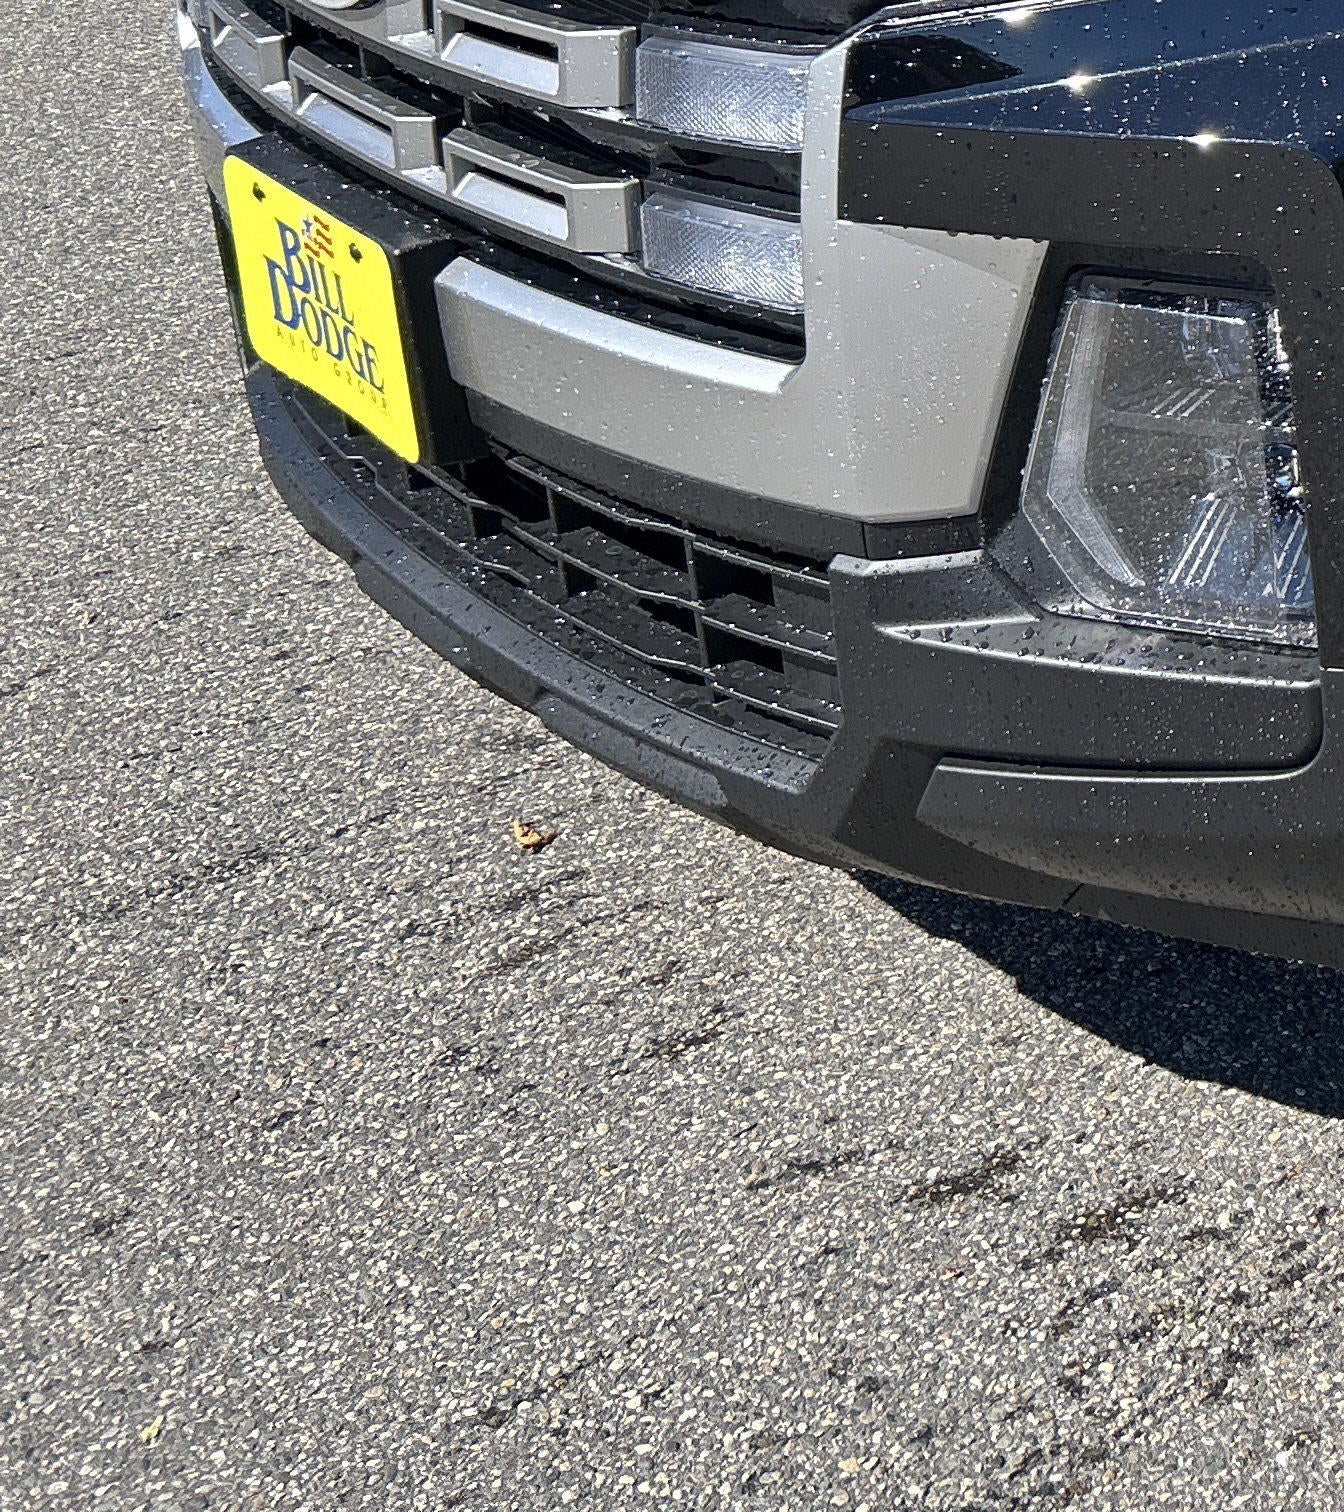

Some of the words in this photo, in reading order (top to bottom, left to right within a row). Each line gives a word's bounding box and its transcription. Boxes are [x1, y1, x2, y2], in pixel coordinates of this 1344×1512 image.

[262, 253, 386, 396] DODGE
[274, 216, 356, 327] BILL
[276, 325, 319, 363] AUTO
